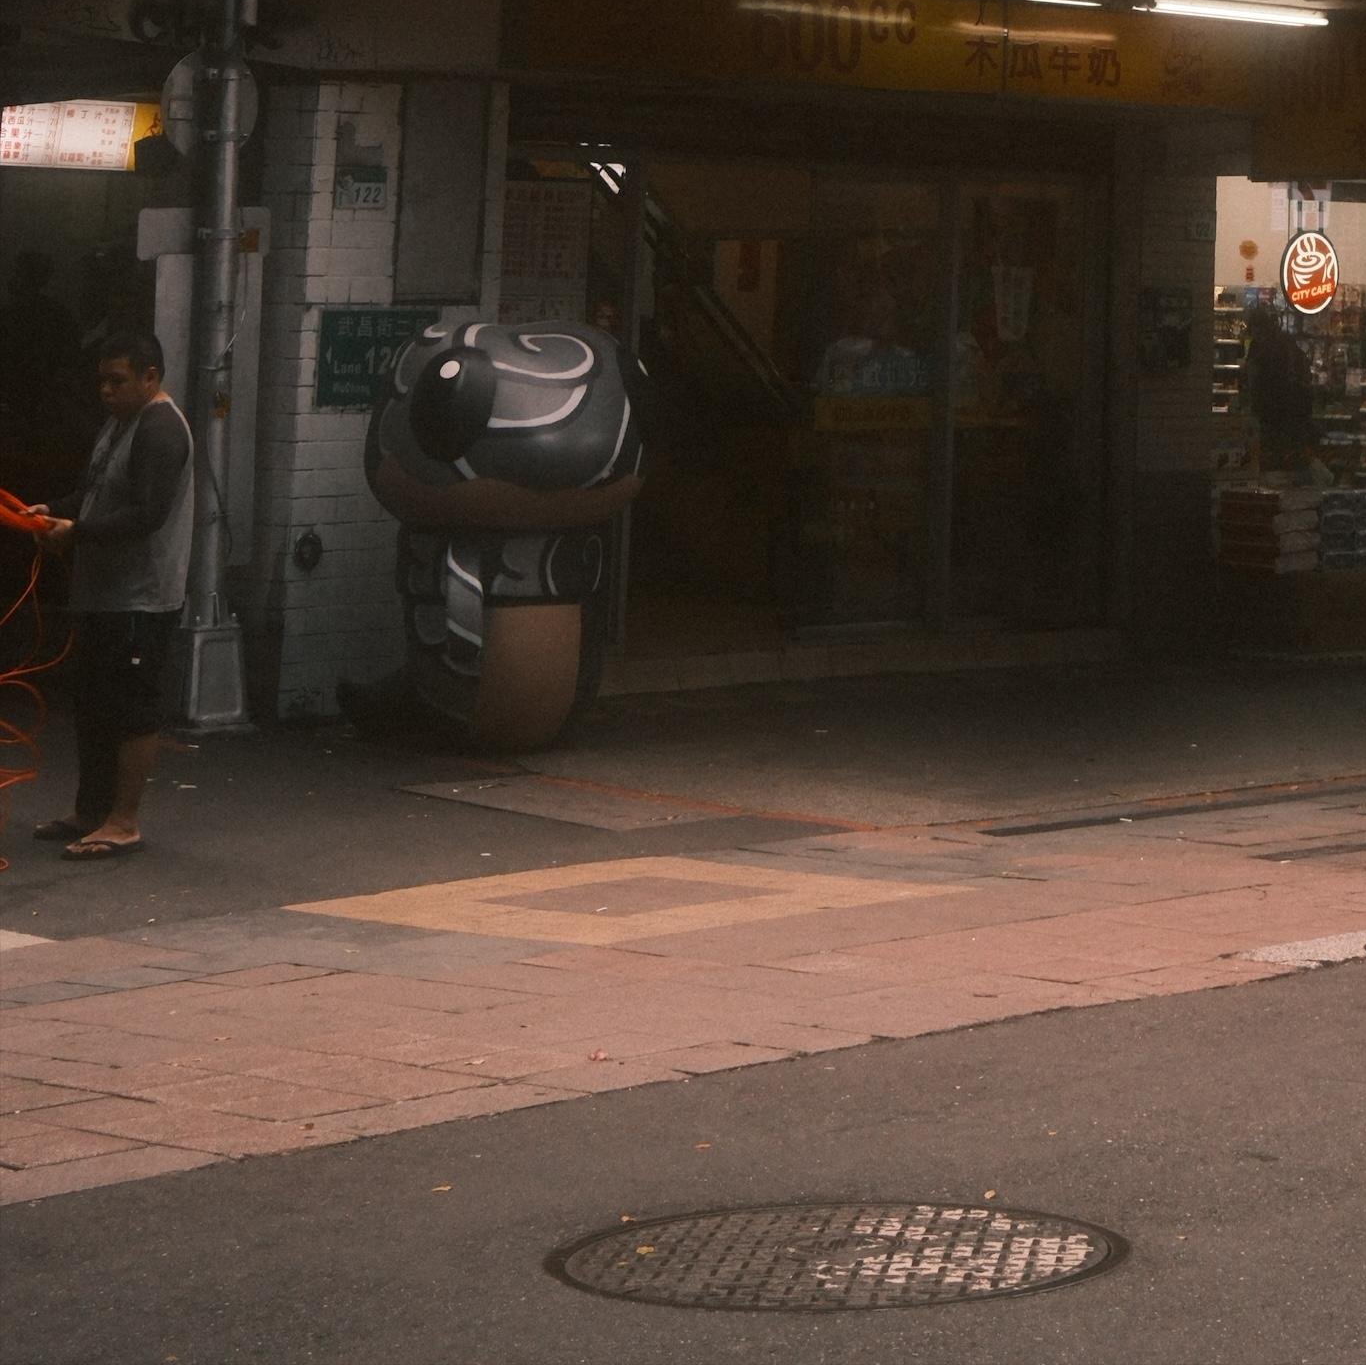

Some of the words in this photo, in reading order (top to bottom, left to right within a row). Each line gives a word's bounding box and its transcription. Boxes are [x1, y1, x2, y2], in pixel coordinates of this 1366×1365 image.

[964, 36, 1123, 87] 木瓜牛奶
[355, 186, 382, 203] 122
[1291, 288, 1311, 302] CITY
